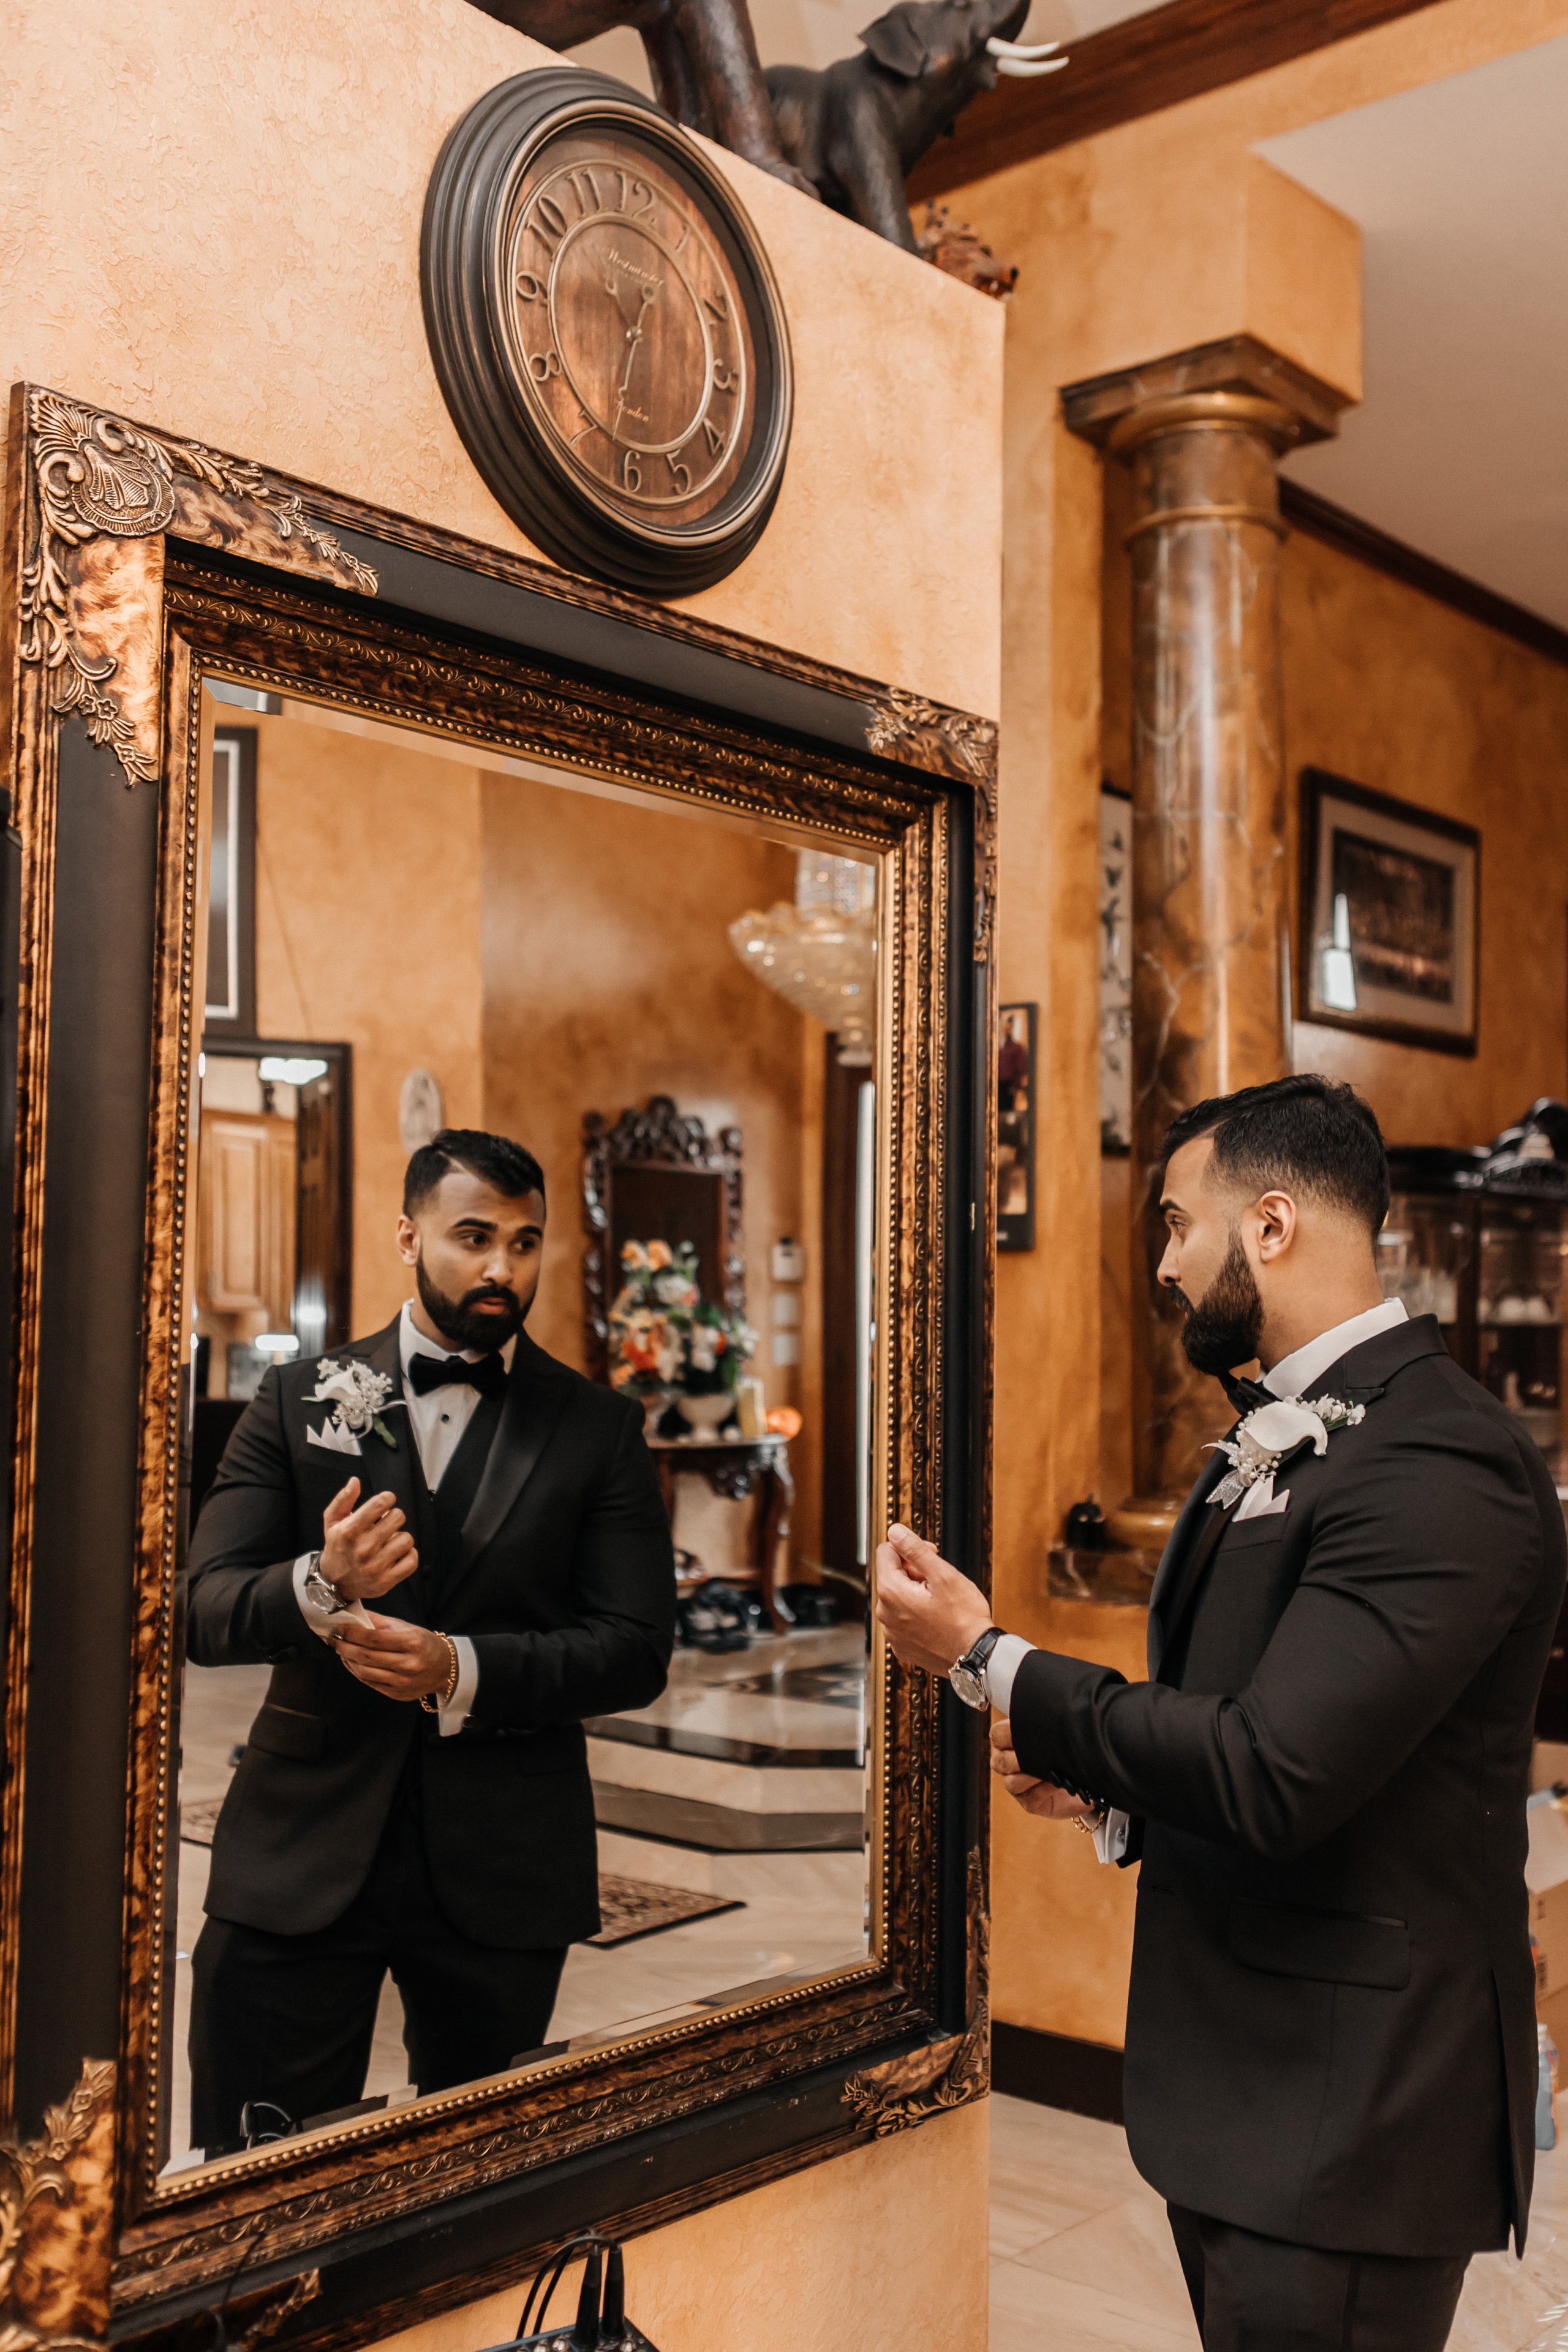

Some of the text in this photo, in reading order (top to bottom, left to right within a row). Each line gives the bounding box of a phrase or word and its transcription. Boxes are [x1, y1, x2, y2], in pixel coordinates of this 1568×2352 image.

[566, 168, 601, 219] 11
[615, 170, 657, 228] 12
[524, 194, 567, 260] 10
[675, 224, 691, 254] 1
[516, 271, 548, 306] 9
[704, 289, 729, 326] 2
[529, 349, 561, 382] 8
[713, 358, 739, 396] 3
[570, 409, 598, 445] 7
[703, 417, 726, 455] 4
[624, 450, 641, 493] 6
[666, 448, 692, 495] 5
